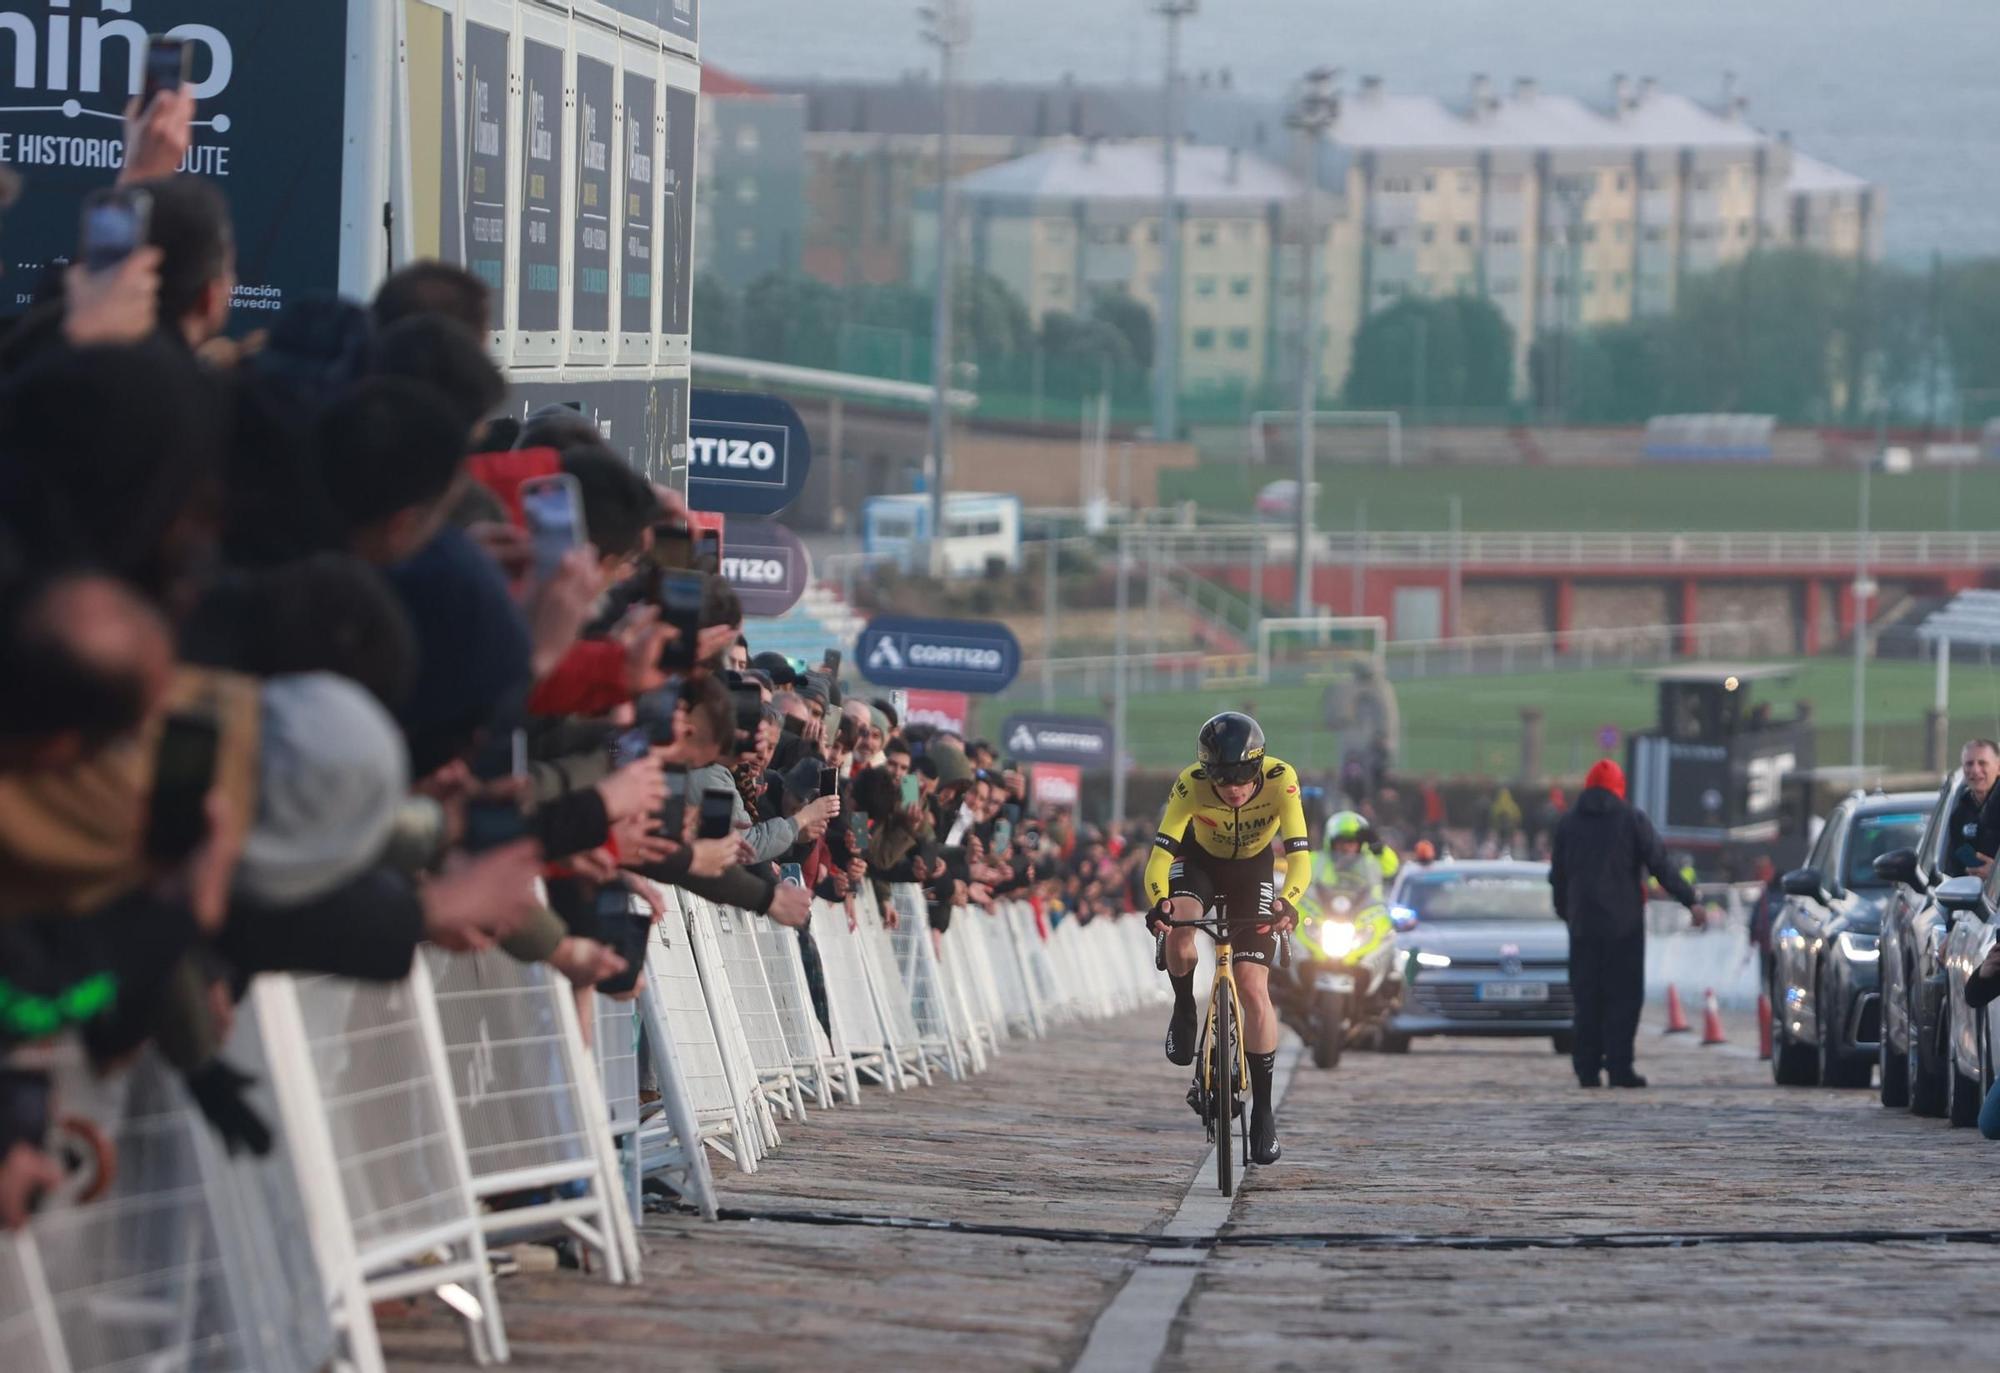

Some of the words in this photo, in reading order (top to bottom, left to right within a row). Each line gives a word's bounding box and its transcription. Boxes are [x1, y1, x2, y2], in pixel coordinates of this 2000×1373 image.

[18, 133, 127, 169] HISTORIC
[722, 557, 784, 584] TIZO
[909, 644, 1002, 671] CORTIZO
[1223, 814, 1275, 831] VISMA
